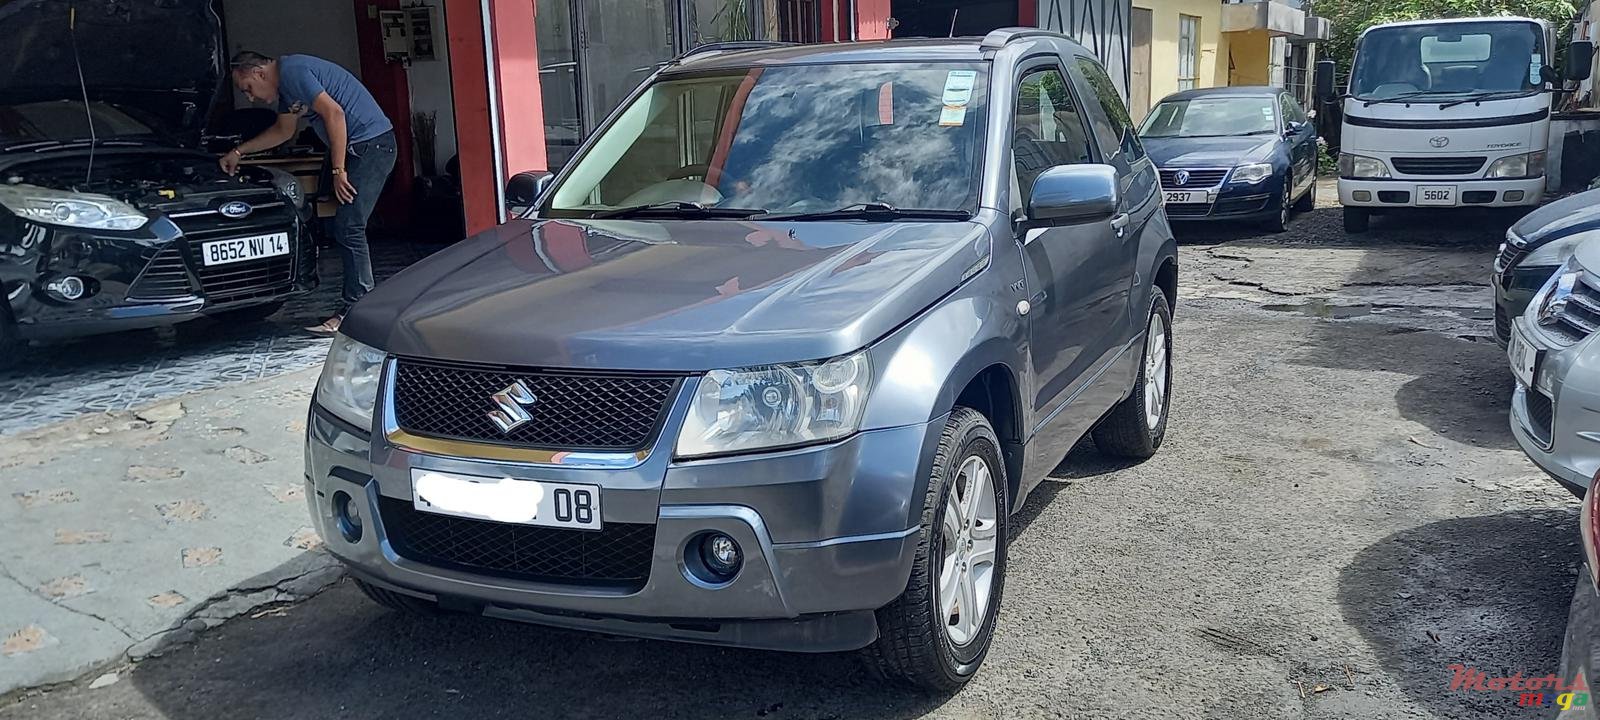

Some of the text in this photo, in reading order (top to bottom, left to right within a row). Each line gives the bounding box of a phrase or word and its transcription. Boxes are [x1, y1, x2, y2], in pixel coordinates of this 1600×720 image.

[1166, 192, 1191, 202] 2937
[1424, 190, 1450, 200] 5602
[227, 203, 247, 214] Ford
[210, 235, 283, 262] 8652 NV 14
[553, 488, 593, 524] 08
